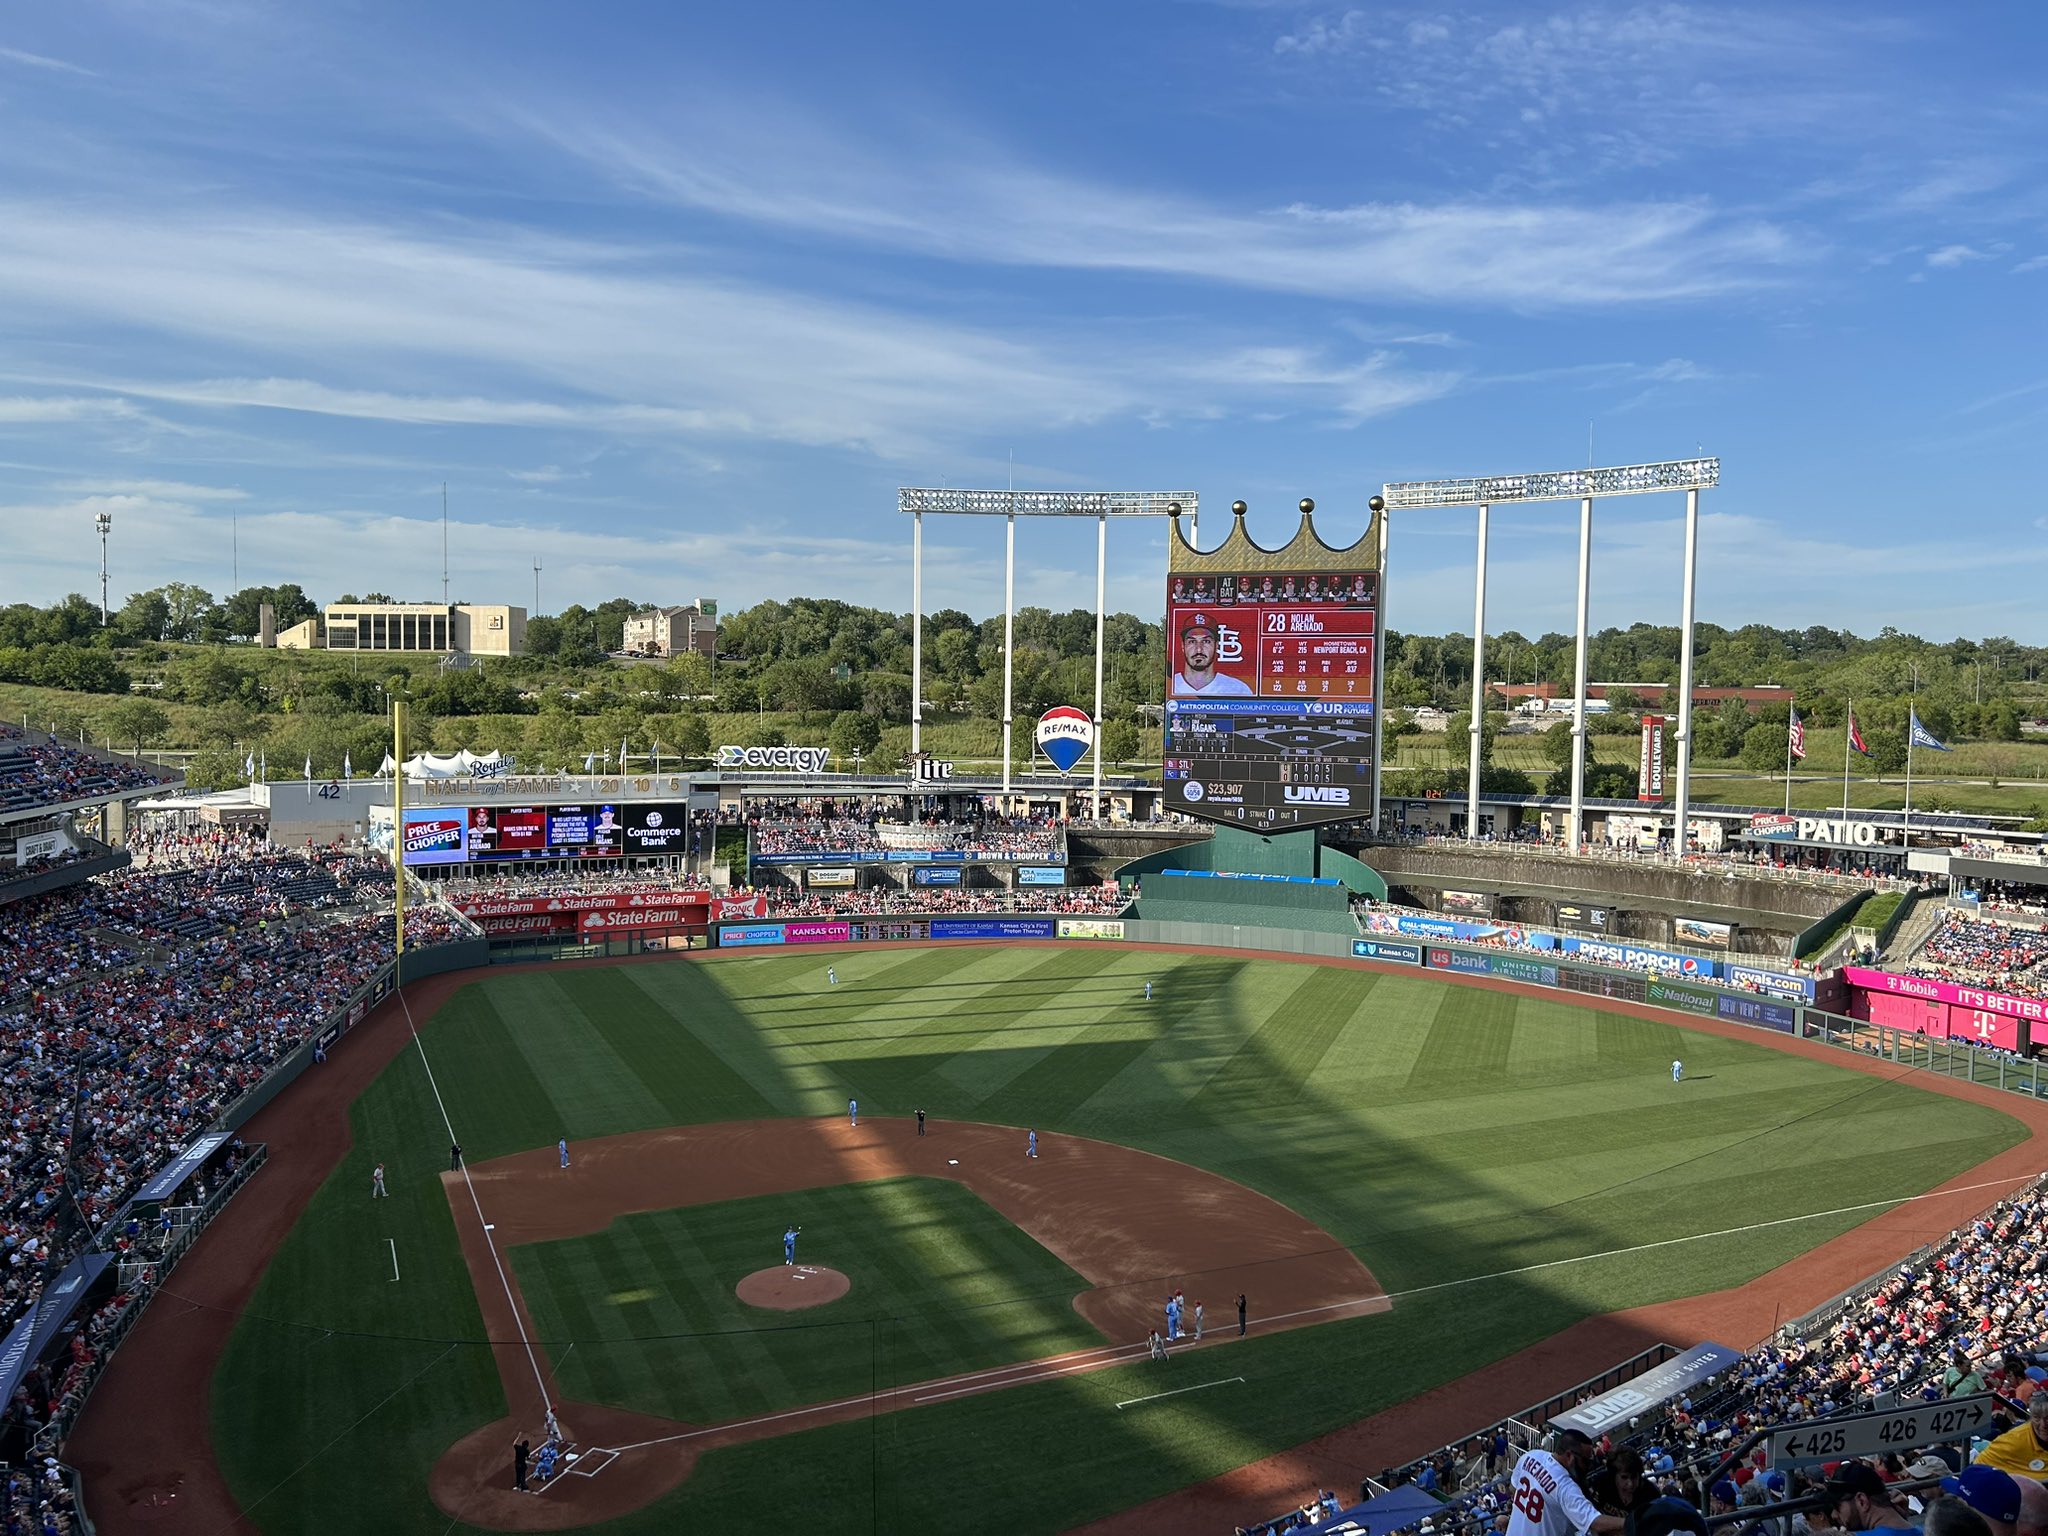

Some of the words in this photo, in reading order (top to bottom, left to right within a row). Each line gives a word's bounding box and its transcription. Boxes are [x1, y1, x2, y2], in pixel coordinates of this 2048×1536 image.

[1222, 577, 1232, 587] AT
[1220, 587, 1234, 597] BAT
[1267, 613, 1286, 632] 28
[1291, 614, 1315, 622] NOLAN
[1290, 622, 1323, 632] ARENADO
[1313, 646, 1339, 654] NEWPORT
[1359, 646, 1367, 654] CA
[1303, 703, 1343, 714] YOUR
[1044, 723, 1086, 736] RE/MAX
[1191, 723, 1217, 732] RAGANS
[470, 754, 516, 779] Royals
[747, 748, 828, 771] evergy
[902, 751, 931, 767] Miller
[1178, 760, 1190, 769] STL
[1304, 764, 1309, 772] 0
[1314, 764, 1319, 772] 0
[1325, 764, 1330, 773] 5
[1640, 729, 1649, 790] BOULEVARD
[1652, 730, 1661, 790] BOULEVARD
[913, 758, 954, 784] Lite
[1180, 770, 1189, 778] KC
[1294, 773, 1298, 782] 0
[1304, 773, 1308, 782] 0
[1314, 774, 1319, 782] 0
[1325, 774, 1330, 783] 5
[424, 778, 480, 796] HALL
[481, 784, 501, 797] of
[504, 777, 561, 794] FAME
[600, 779, 619, 793] 20
[634, 779, 650, 792] 10
[668, 777, 680, 791] 5
[317, 784, 340, 800] 42
[1207, 782, 1243, 796] $23,907
[1284, 785, 1350, 802] UMB
[1223, 809, 1236, 817] BALL
[1237, 807, 1245, 820] 0
[1249, 810, 1266, 818] STRIKE
[1268, 808, 1275, 821] 0
[1293, 809, 1298, 822] 1
[1754, 815, 1780, 826] PRICE
[408, 821, 441, 838] PRICE
[627, 827, 681, 837] Commerce
[1753, 825, 1794, 837] CHOPPER
[1798, 817, 1876, 846] PATIO
[406, 830, 460, 850] CHOPPER
[641, 835, 667, 846] Bank
[25, 844, 39, 857] CRAFT
[42, 840, 56, 852] DRAFT
[977, 851, 1002, 860] BROWN
[1003, 852, 1010, 860] &
[1011, 852, 1050, 860] CROUPPEN
[725, 904, 753, 914] SONIC
[1590, 910, 1606, 925] KC
[792, 928, 826, 936] KANSAS
[827, 927, 847, 935] CITY
[1406, 921, 1454, 933] ALL-INCLUSIVE
[724, 932, 745, 940] PRICE
[746, 930, 776, 939] CHOPPER
[1378, 947, 1402, 957] Kansas
[1402, 950, 1416, 960] City
[1431, 952, 1449, 963] us
[1451, 952, 1487, 969] bank
[1579, 942, 1623, 962] PEPSI
[1625, 949, 1681, 971] PORCH
[1492, 966, 1538, 980] AIRLINES
[1501, 960, 1539, 973] UNITED
[1734, 969, 1802, 992] royals.com
[1899, 979, 1938, 997] Mobile
[1664, 988, 1714, 1008] National
[1958, 989, 1984, 1007] IT'S
[1987, 996, 2042, 1019] BETTER
[1692, 1004, 1712, 1013] Rental
[1739, 1001, 1754, 1018] VIEW
[1570, 1387, 1648, 1427] UMB
[1643, 1369, 1684, 1393] DUGOUT
[1683, 1352, 1718, 1372] SUITES
[1806, 1428, 1846, 1456] 425
[1879, 1417, 1917, 1444] 426
[1930, 1408, 1967, 1435] 427
[1513, 1476, 1545, 1525] 28
